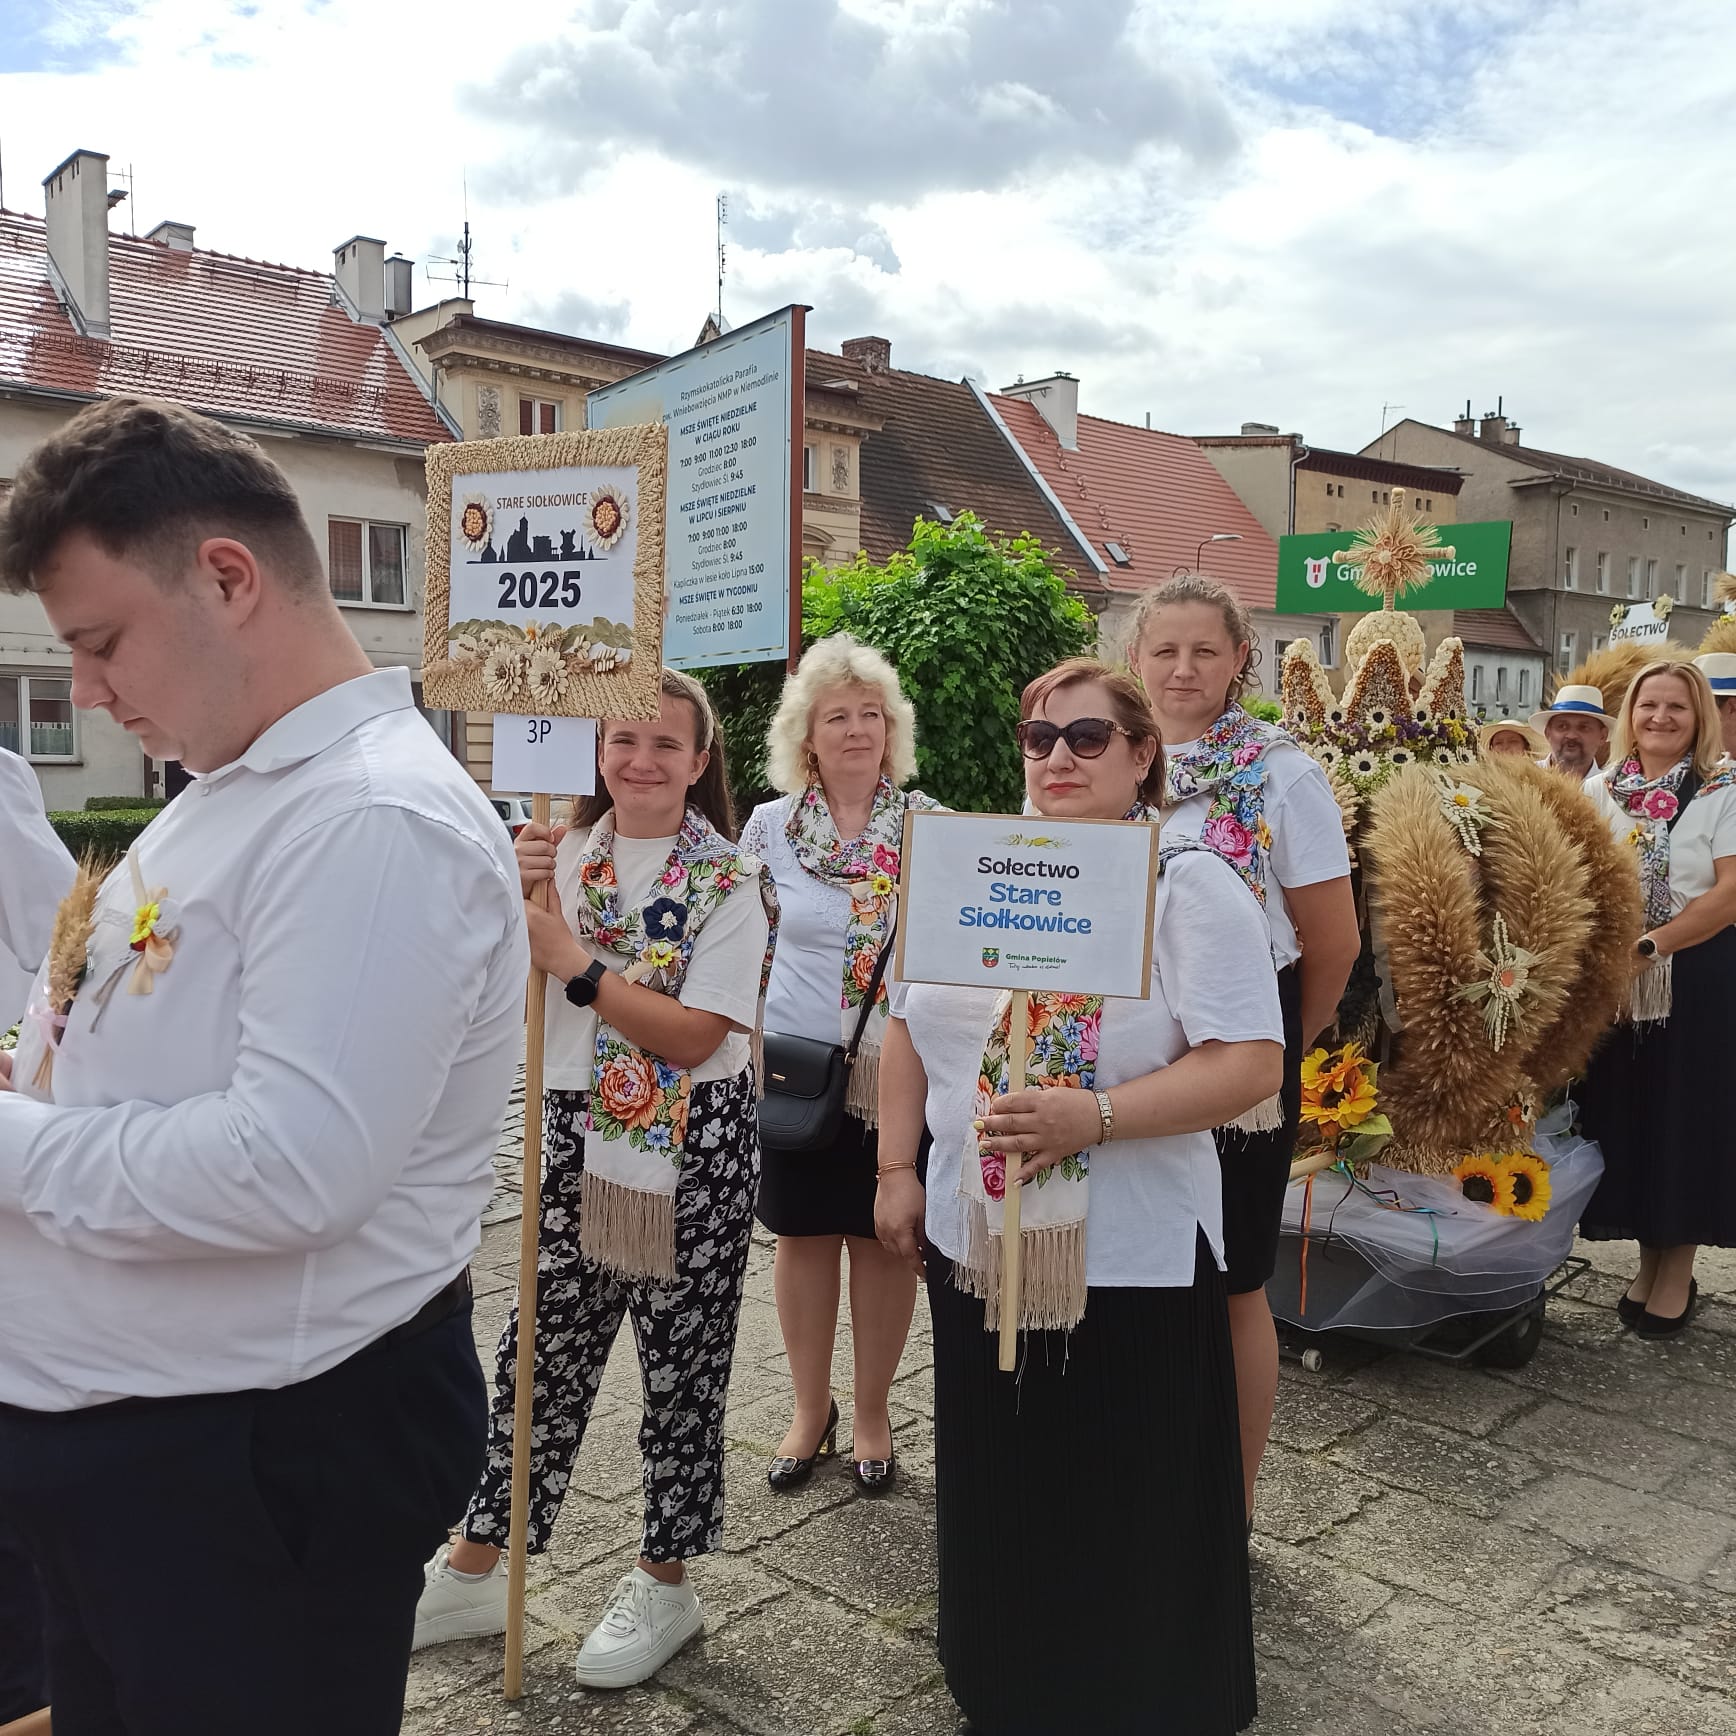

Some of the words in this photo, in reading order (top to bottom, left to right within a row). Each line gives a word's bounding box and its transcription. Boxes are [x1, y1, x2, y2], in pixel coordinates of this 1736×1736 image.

[673, 396, 717, 418] Wniebowzięcia
[717, 389, 733, 402] NMP
[733, 387, 740, 396] w
[740, 371, 779, 393] Niemodlinie
[680, 373, 734, 402] Rzymskokatolicka
[735, 364, 758, 381] Parafia
[680, 423, 696, 437] MSZE
[696, 414, 720, 431] ŚWIĘTE
[720, 402, 757, 421] NIEDZIELNE
[695, 436, 702, 445] W
[702, 429, 721, 443] CIĄGU
[722, 422, 741, 436] ROKU
[680, 457, 692, 469] 7:00
[694, 452, 707, 464] 9:00
[709, 447, 723, 459] 11:00
[723, 442, 738, 455] 12:30
[741, 436, 757, 450] 18:00
[698, 463, 722, 477] Grodziec
[723, 457, 737, 470] 8:00
[730, 469, 744, 482] 9:45
[496, 496, 525, 510] STARE
[526, 492, 588, 509] SIOŁKOWICE
[680, 501, 696, 513] MSZE
[696, 495, 719, 509] ŚWIĘTE
[720, 484, 757, 504] NIEDZIELNE
[688, 515, 695, 525] W
[696, 511, 713, 523] LIPCU
[718, 502, 747, 518] SIERPNIU
[688, 532, 700, 544] 7:00
[702, 529, 715, 540] 9:00
[716, 525, 729, 537] 11:00
[732, 521, 748, 533] 18:00
[698, 543, 722, 555] Grodziec
[723, 538, 737, 550] 8:00
[730, 551, 743, 562] 9:45
[674, 576, 698, 589] Kapliczka
[704, 573, 718, 583] lesie
[718, 570, 731, 580] koło
[731, 568, 748, 579] Lipna
[748, 563, 764, 575] 15:00
[497, 571, 582, 609] 2025
[679, 594, 694, 605] MSZE
[695, 590, 717, 603] ŚWIĘTE
[718, 589, 725, 599] W
[726, 583, 758, 597] TYGODNIU
[675, 610, 709, 623] Poniedziałek
[713, 607, 731, 619] Piątek
[731, 605, 744, 616] 6:30
[746, 602, 763, 613] 18:00
[692, 625, 712, 635] Sobota
[712, 622, 725, 632] 8:00
[727, 619, 743, 630] 18:00
[1611, 622, 1667, 641] SOŁECTWO
[527, 720, 551, 743] 3P
[977, 857, 1080, 879] Sołectwo
[989, 883, 1062, 906] Stare
[959, 907, 1092, 935] Siołkowice
[1005, 953, 1030, 962] Gmina
[1031, 955, 1067, 964] Popielów
